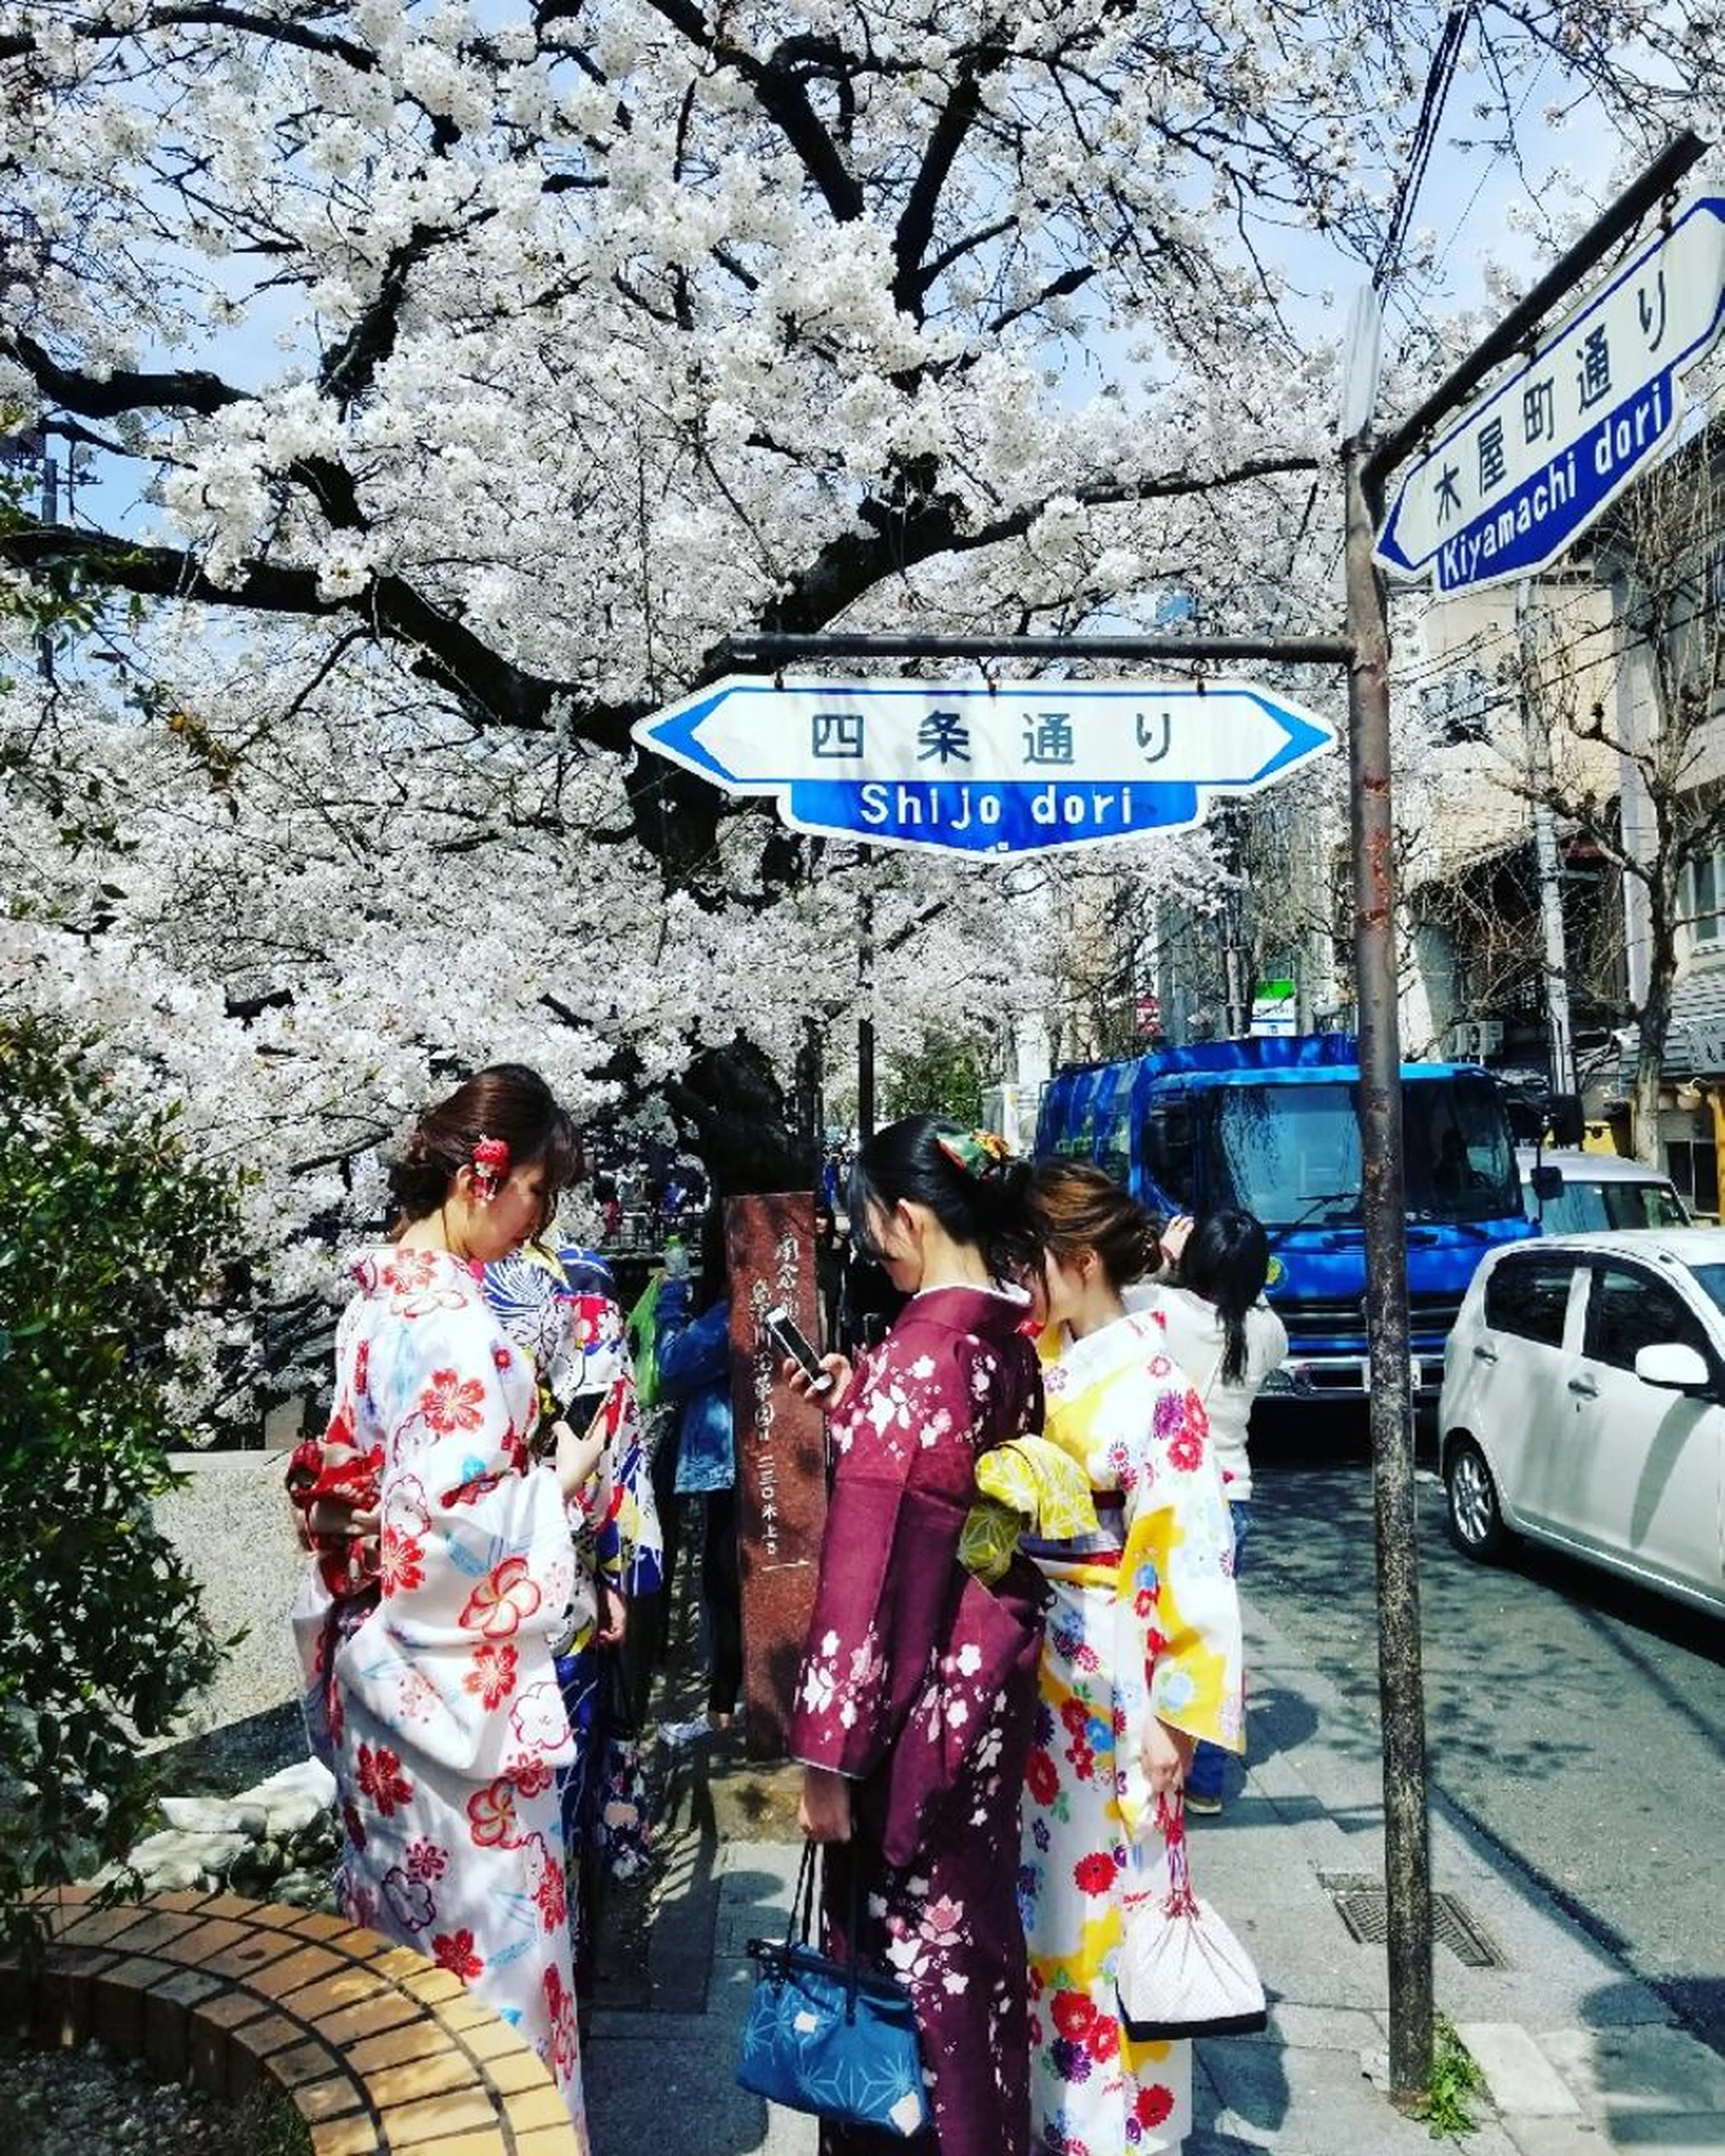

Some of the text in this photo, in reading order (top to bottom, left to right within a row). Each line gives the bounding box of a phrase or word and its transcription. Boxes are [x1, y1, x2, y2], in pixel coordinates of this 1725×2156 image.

[1433, 271, 1666, 527] 木屋町通り
[1443, 384, 1662, 588] Kiyamachi dori
[812, 710, 1171, 764] 四条通り
[861, 784, 1131, 829] Shijo dori
